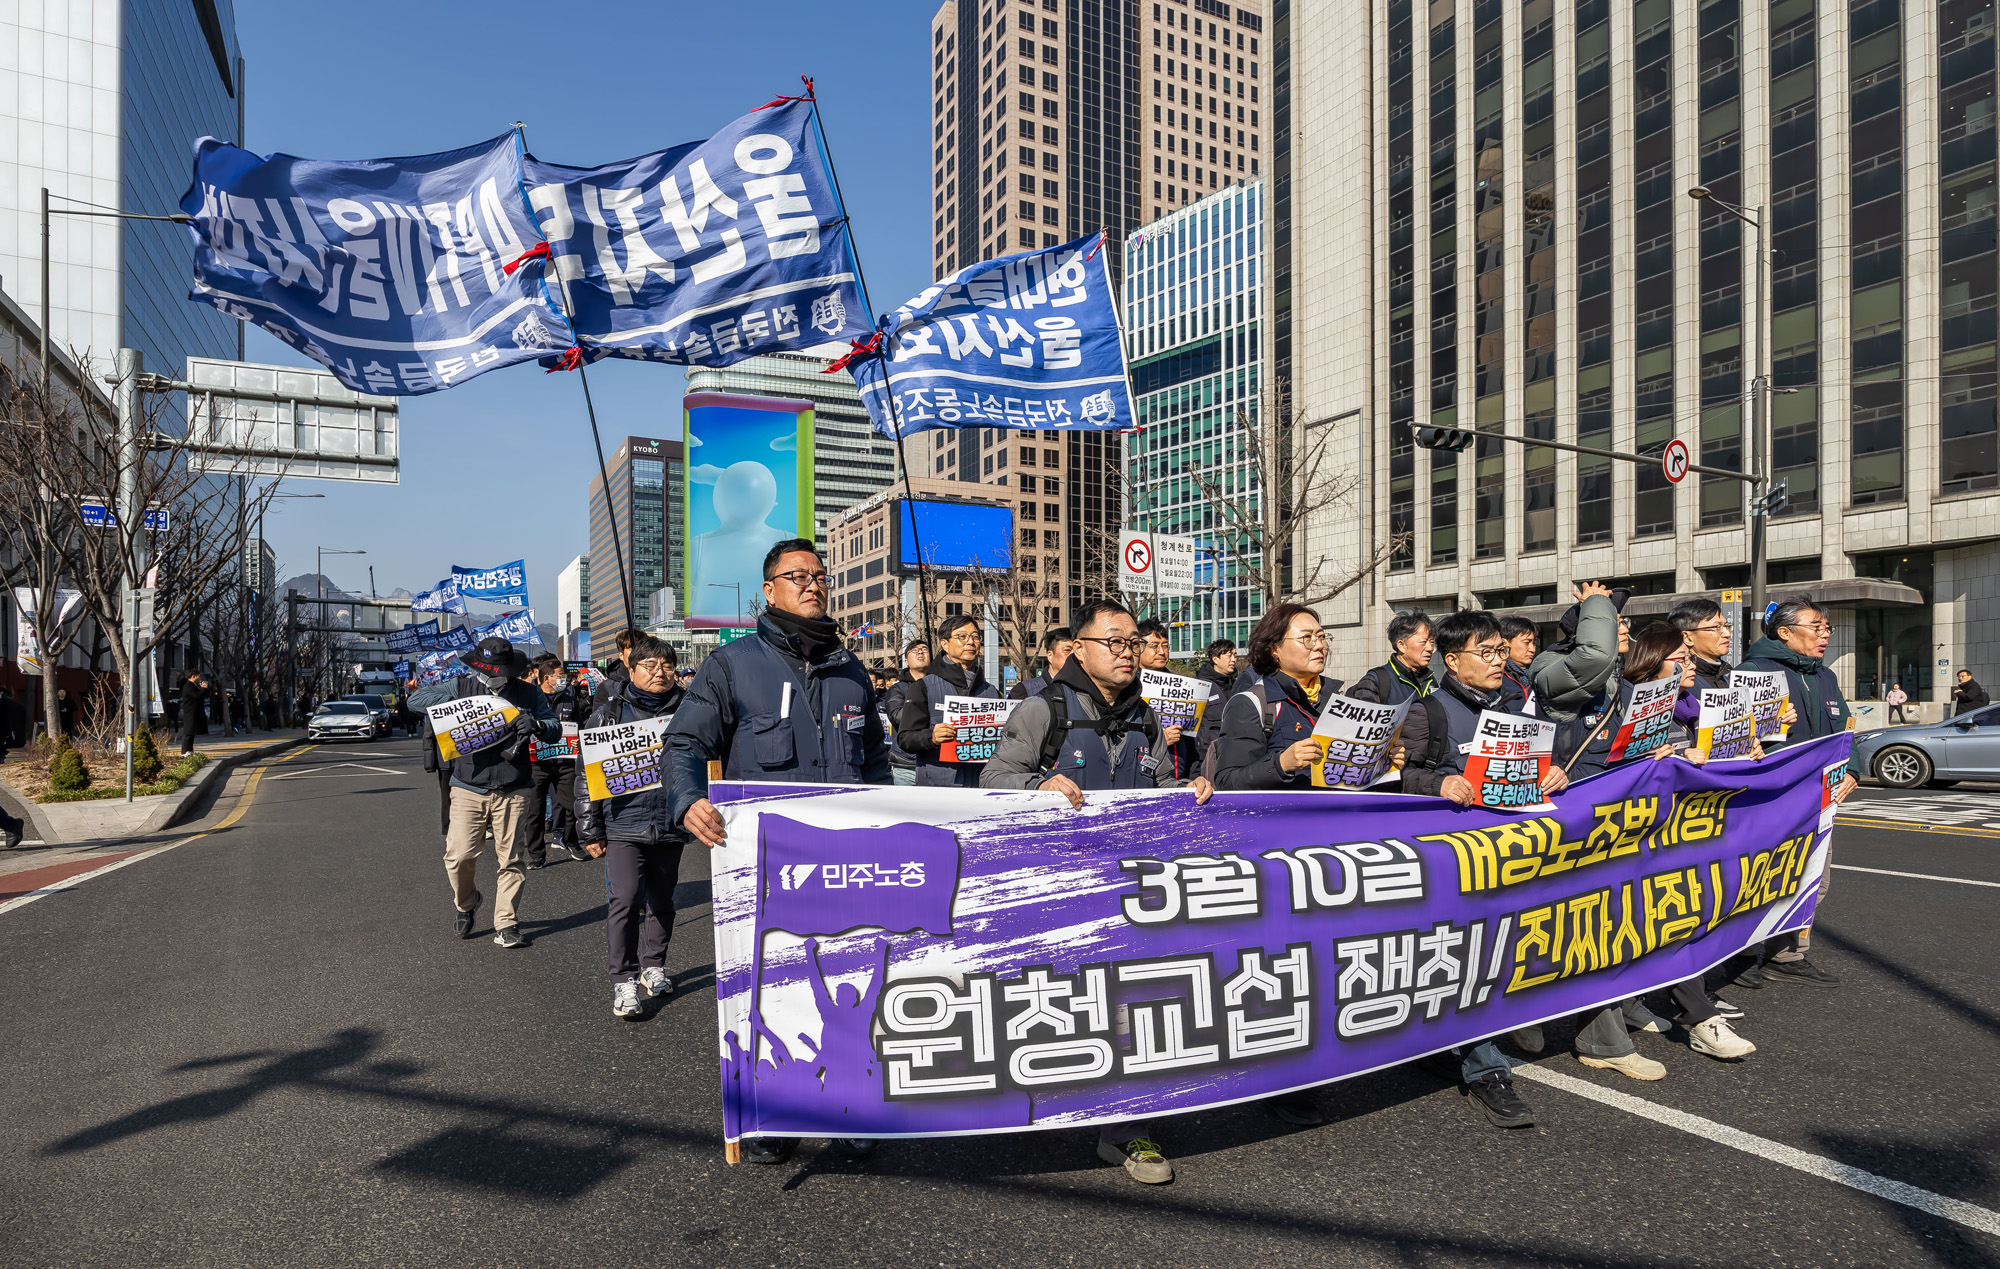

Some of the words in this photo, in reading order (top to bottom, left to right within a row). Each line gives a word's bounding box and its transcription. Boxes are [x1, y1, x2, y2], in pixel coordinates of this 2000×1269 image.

[633, 445, 659, 454] KYOBO
[1160, 541, 1193, 553] 청계천로
[1142, 672, 1183, 688] 진짜사장
[1733, 674, 1774, 689] 진짜사장
[1161, 688, 1194, 700] 나와라!
[1632, 689, 1653, 706] 모든
[1653, 677, 1681, 700] 노동자
[1704, 691, 1740, 708] 진짜사장
[1753, 685, 1781, 702] 나와라!
[431, 699, 474, 720] 진짜사장
[456, 702, 494, 724] 나와라!
[946, 700, 970, 714] 모든
[971, 701, 1007, 713] 노동자의
[1148, 698, 1197, 717] 원청교섭
[1328, 699, 1396, 725] 진짜사장
[1629, 694, 1675, 722] 노동기본권
[1723, 700, 1747, 722] 나와라!
[1752, 700, 1783, 722] 청교섭
[450, 712, 506, 743] 원청교섭
[949, 713, 996, 726] 노동기본권
[1480, 718, 1511, 738] 모든
[1512, 722, 1540, 739] 노동자의
[583, 725, 635, 746] 진짜사장
[1712, 718, 1751, 745] 원청교섭
[536, 746, 573, 761] 쟁취하자!
[612, 731, 658, 755] 나와라!
[1480, 740, 1531, 756] 노동기본권
[1485, 757, 1538, 782] 투쟁으로
[605, 766, 663, 795] 쟁취하
[1481, 782, 1543, 806] 쟁취하자!
[1119, 854, 1260, 924] 3월
[1263, 838, 1425, 913] 10일
[1416, 796, 1659, 894] 개정노조법
[822, 861, 926, 890] 민주노총
[880, 944, 1311, 1098] 원청교섭
[1336, 916, 1512, 1039] 쟁취!
[1505, 865, 1703, 994] 진짜사장
[1706, 832, 1814, 933] 나와라!
